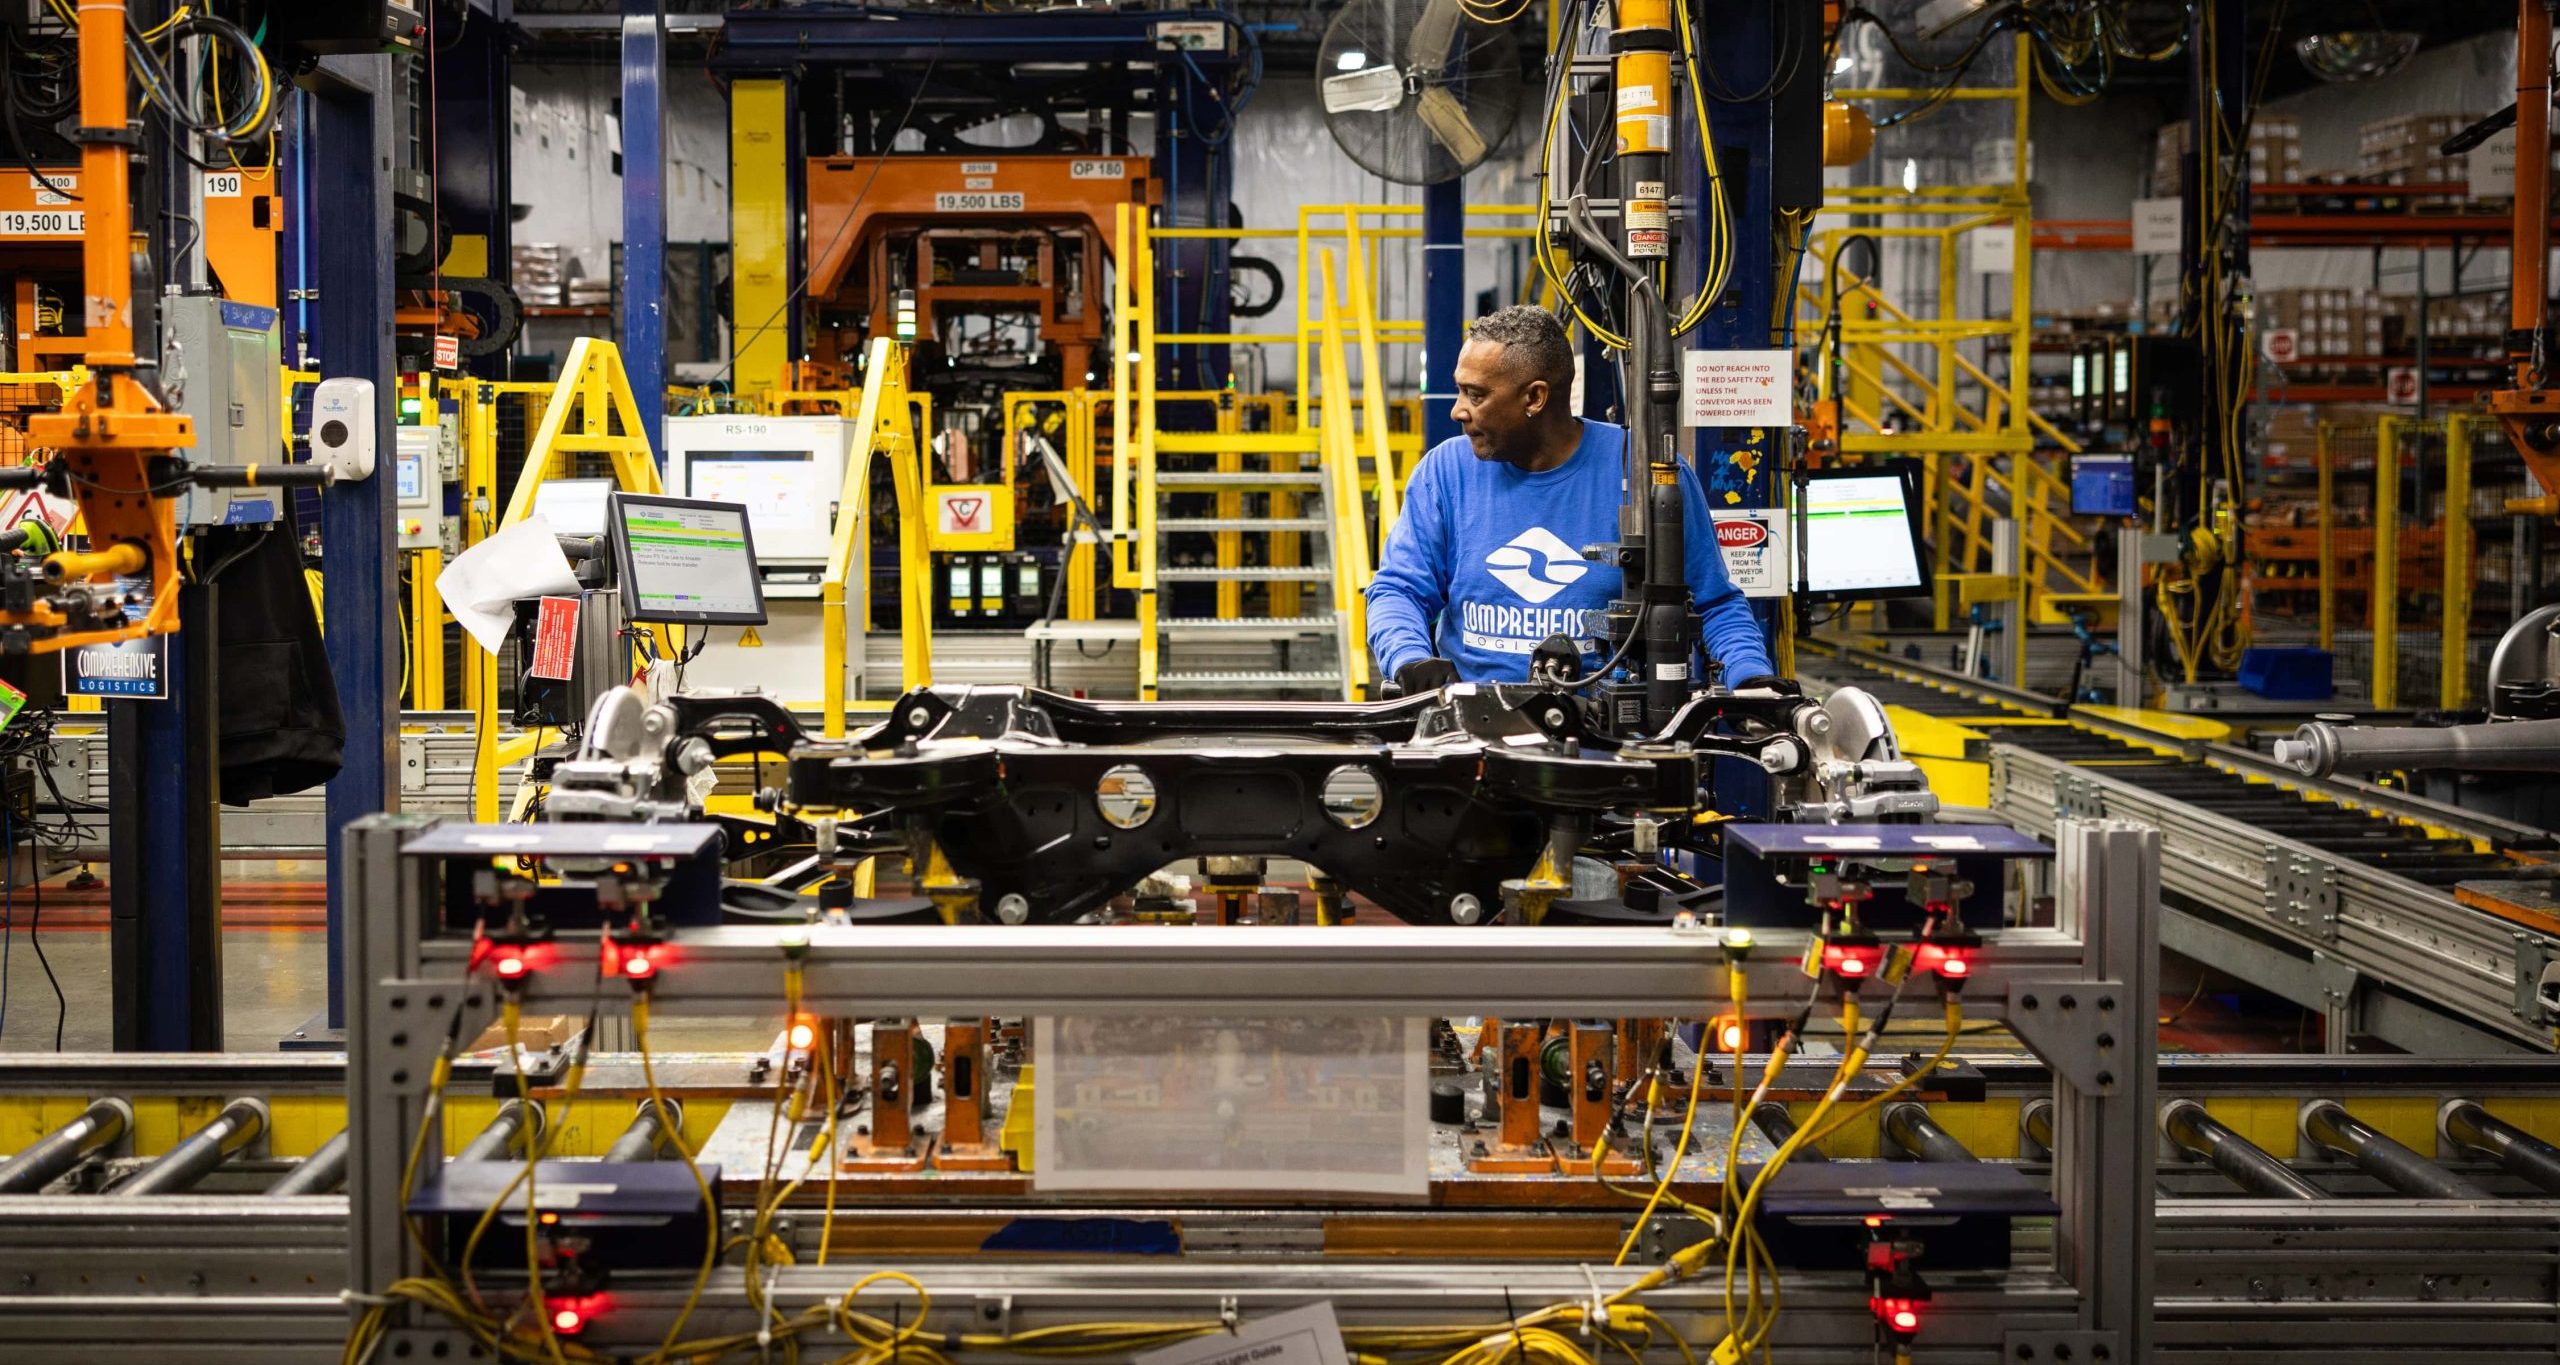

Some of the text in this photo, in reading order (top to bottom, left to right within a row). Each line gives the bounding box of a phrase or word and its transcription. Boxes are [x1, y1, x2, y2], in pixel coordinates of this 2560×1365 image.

[1073, 162, 1122, 176] OP 180
[207, 177, 238, 193] 190
[938, 195, 1021, 211] 19,500 LBS
[5, 214, 62, 234] 19,500
[436, 350, 456, 362] STOP
[1696, 365, 1708, 373] DO
[1709, 365, 1725, 373] NOT
[1696, 376, 1710, 384] THE
[1711, 376, 1726, 384] RED
[1696, 387, 1738, 395] UNLESS THE
[1695, 398, 1772, 406] CONVEYOR HAS BEEN
[1696, 409, 1732, 417] POWERED
[726, 425, 767, 434] RS-190
[1717, 527, 1759, 541] ANGER
[77, 649, 156, 678] COMPREHENSIVE
[80, 681, 155, 692] LOGISTICS
